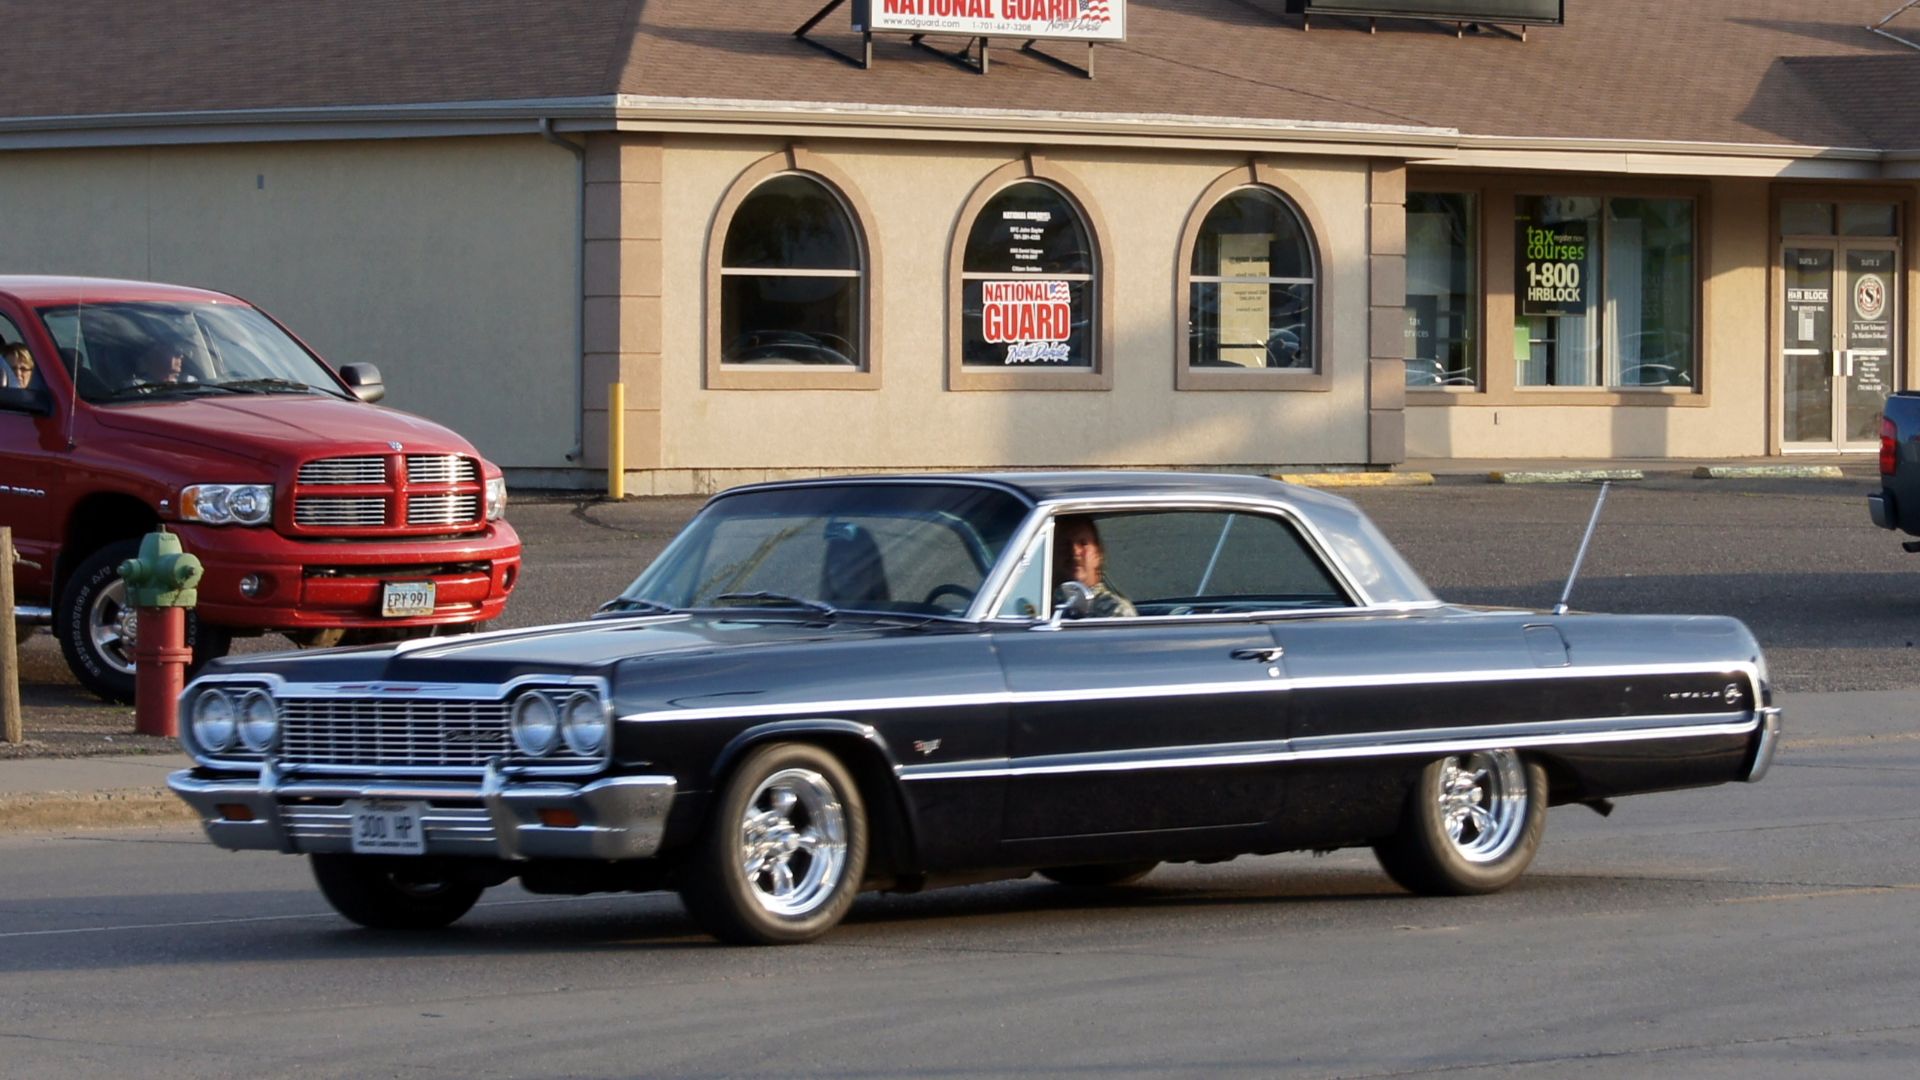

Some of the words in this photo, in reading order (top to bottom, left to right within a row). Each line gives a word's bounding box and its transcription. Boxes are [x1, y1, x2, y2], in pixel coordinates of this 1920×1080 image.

[883, 0, 994, 19] NATIONAL
[1001, 0, 1078, 21] GUARD
[883, 17, 960, 29] www.ndguard.com
[1526, 225, 1555, 245] tax
[1527, 245, 1584, 260] courses
[1526, 262, 1580, 288] 1-800
[984, 283, 1051, 301] NATIONAL
[1527, 287, 1581, 301] HRBLOCK
[1804, 291, 1828, 300] BLOCK
[984, 303, 1069, 341] GUARD
[387, 592, 408, 608] EPY
[410, 592, 428, 608] 991
[358, 815, 387, 839] 300
[394, 815, 413, 839] HP
